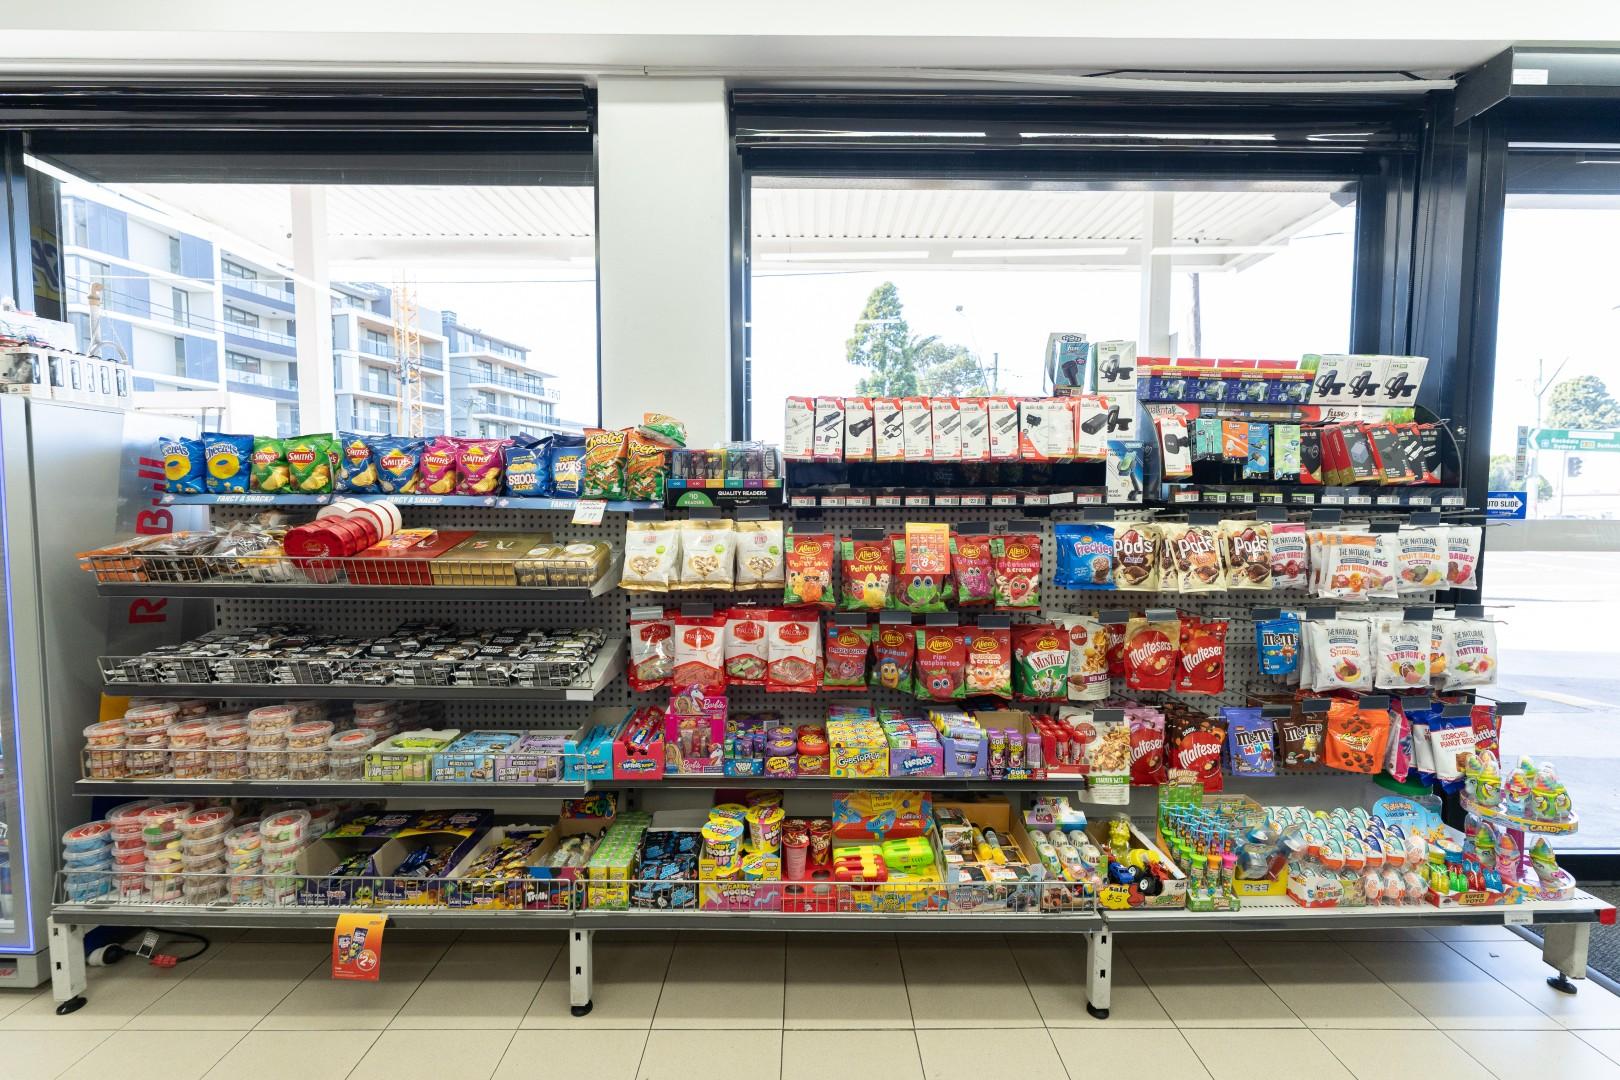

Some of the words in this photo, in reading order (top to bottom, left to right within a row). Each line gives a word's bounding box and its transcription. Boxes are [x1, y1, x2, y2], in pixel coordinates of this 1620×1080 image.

[288, 452, 314, 461] SMITH'S
[346, 448, 369, 457] SMITH'S
[424, 455, 450, 464] SMITH'S
[1500, 500, 1519, 508] SLIDE
[1114, 536, 1153, 557] Pods
[1177, 535, 1215, 558] Pods
[1234, 535, 1267, 558] Pods
[1399, 538, 1409, 546] THE
[1409, 538, 1438, 546] NATURAL
[798, 544, 819, 554] Allen's
[1009, 547, 1029, 556] Allen's
[1074, 541, 1112, 557] Freckles
[1348, 548, 1371, 558] NATURAL
[858, 550, 880, 559] Allen's
[929, 639, 951, 649] Allen's
[975, 640, 997, 648] Allen's
[1129, 641, 1171, 669] Maltesers
[1182, 646, 1222, 673] Malteser
[703, 699, 726, 710] Barbie
[1178, 742, 1221, 769] Malteser
[1109, 886, 1128, 894] sale
[1106, 894, 1122, 903] $5
